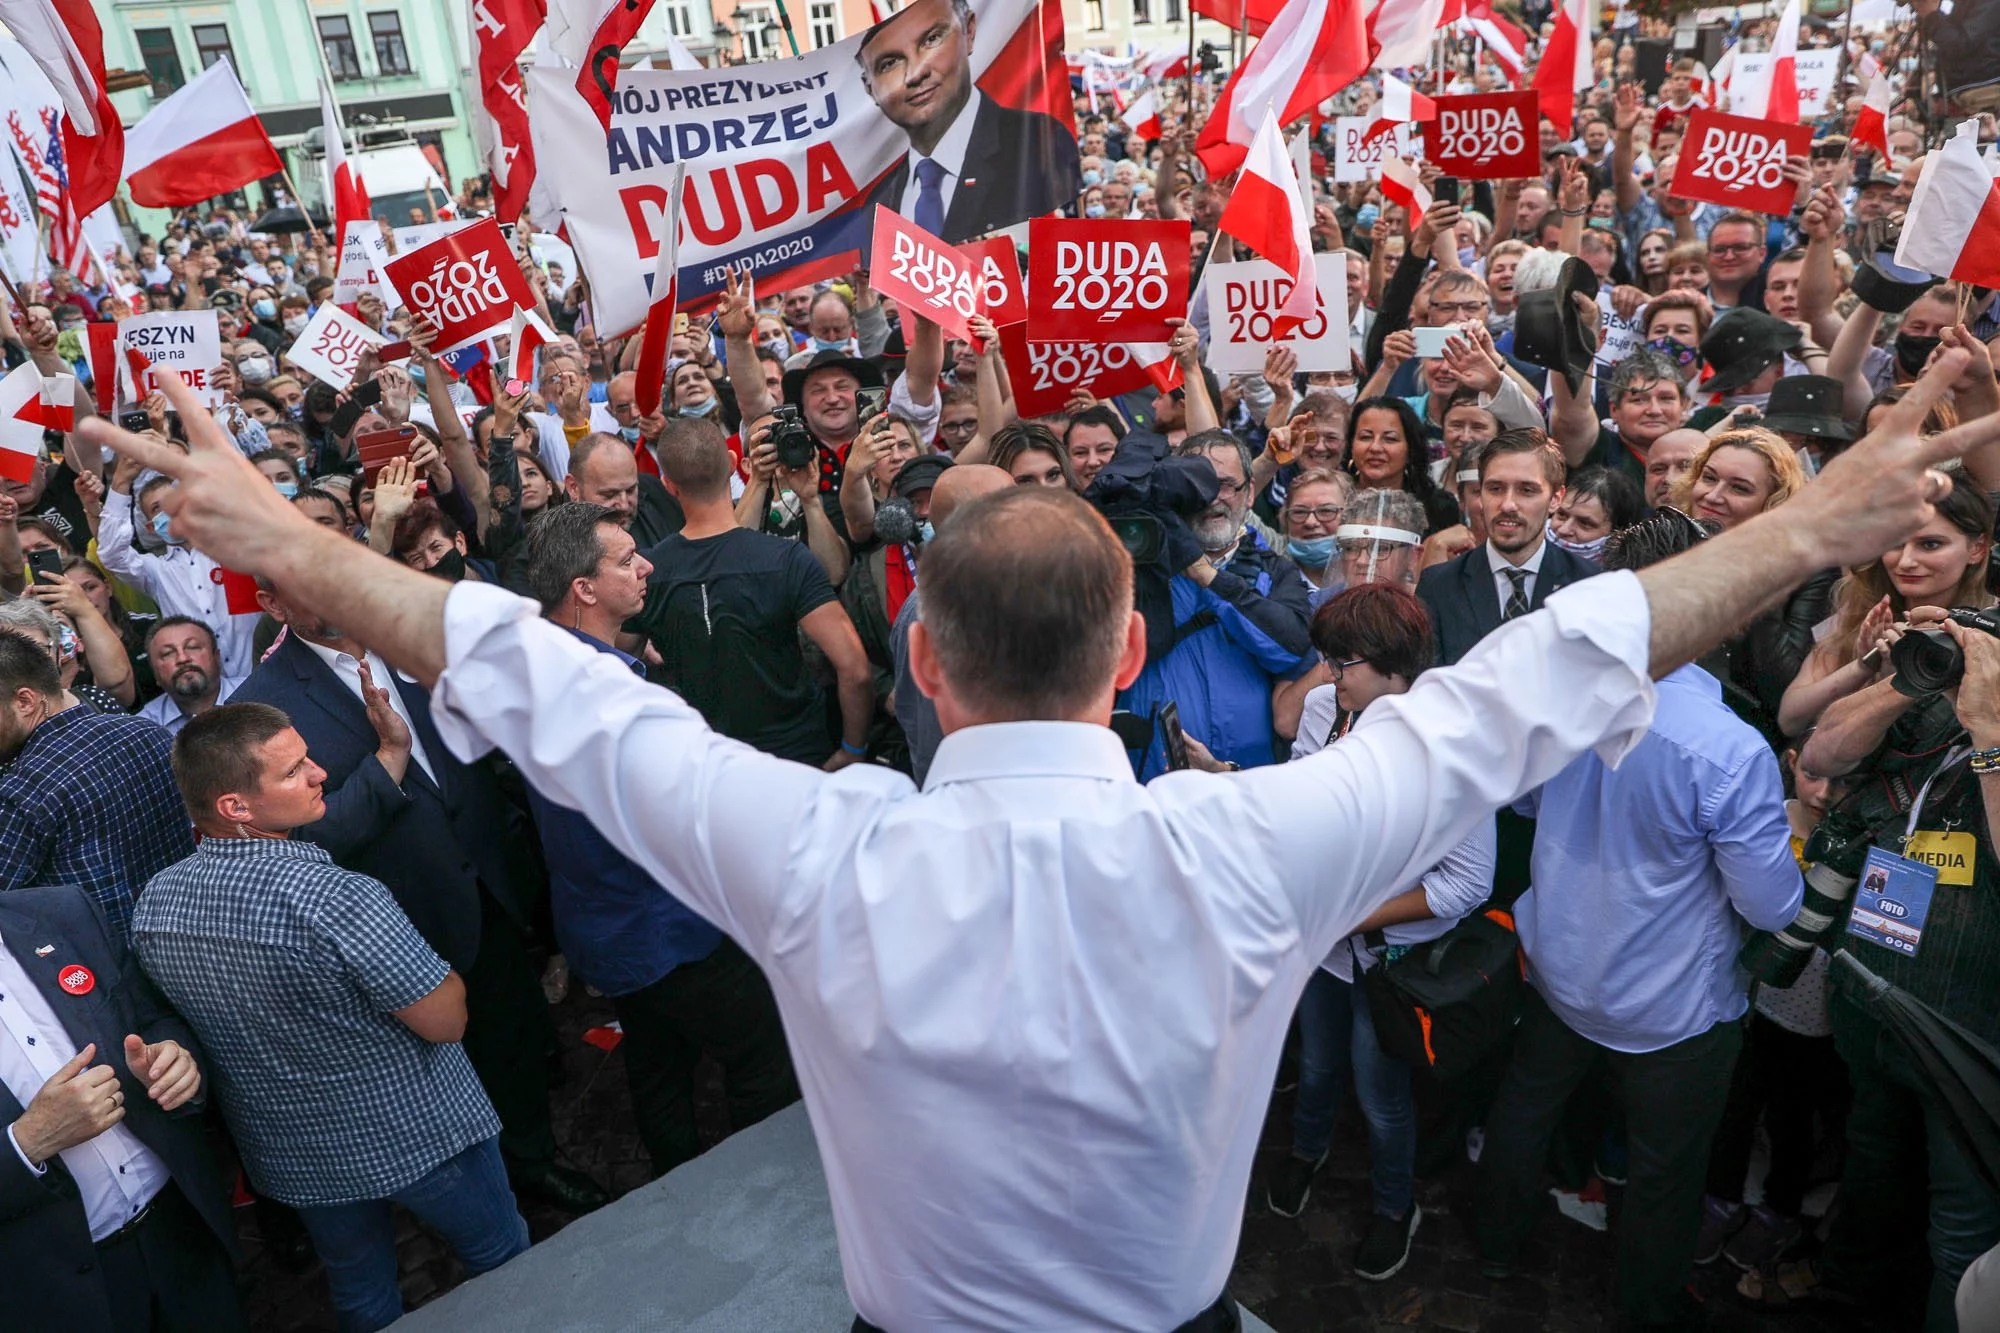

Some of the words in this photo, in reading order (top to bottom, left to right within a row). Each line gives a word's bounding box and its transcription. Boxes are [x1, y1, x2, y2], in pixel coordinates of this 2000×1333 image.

[664, 71, 829, 111] PREZYDENT
[609, 91, 839, 175] ANDRZEJ
[1347, 128, 1398, 146] DDA
[1440, 106, 1524, 135] DUDA
[1439, 130, 1525, 159] 2020
[1702, 127, 1787, 165] DUDA
[1692, 152, 1785, 190] 2020
[618, 140, 859, 260] DUDA
[703, 235, 814, 286] #DUDA2020
[893, 230, 976, 300] DUDA
[1056, 241, 1169, 276] DUDA
[410, 249, 497, 309] 2020
[889, 252, 977, 319] 2020
[1051, 274, 1169, 310] 2020
[420, 275, 510, 331] DUDA
[169, 349, 185, 360] na
[311, 337, 361, 377] 202
[321, 318, 371, 358] DUD
[148, 368, 206, 391] DDĘ
[1030, 342, 1131, 391] 2020
[1910, 851, 1966, 869] MEDIA
[1879, 898, 1905, 918] FOTO
